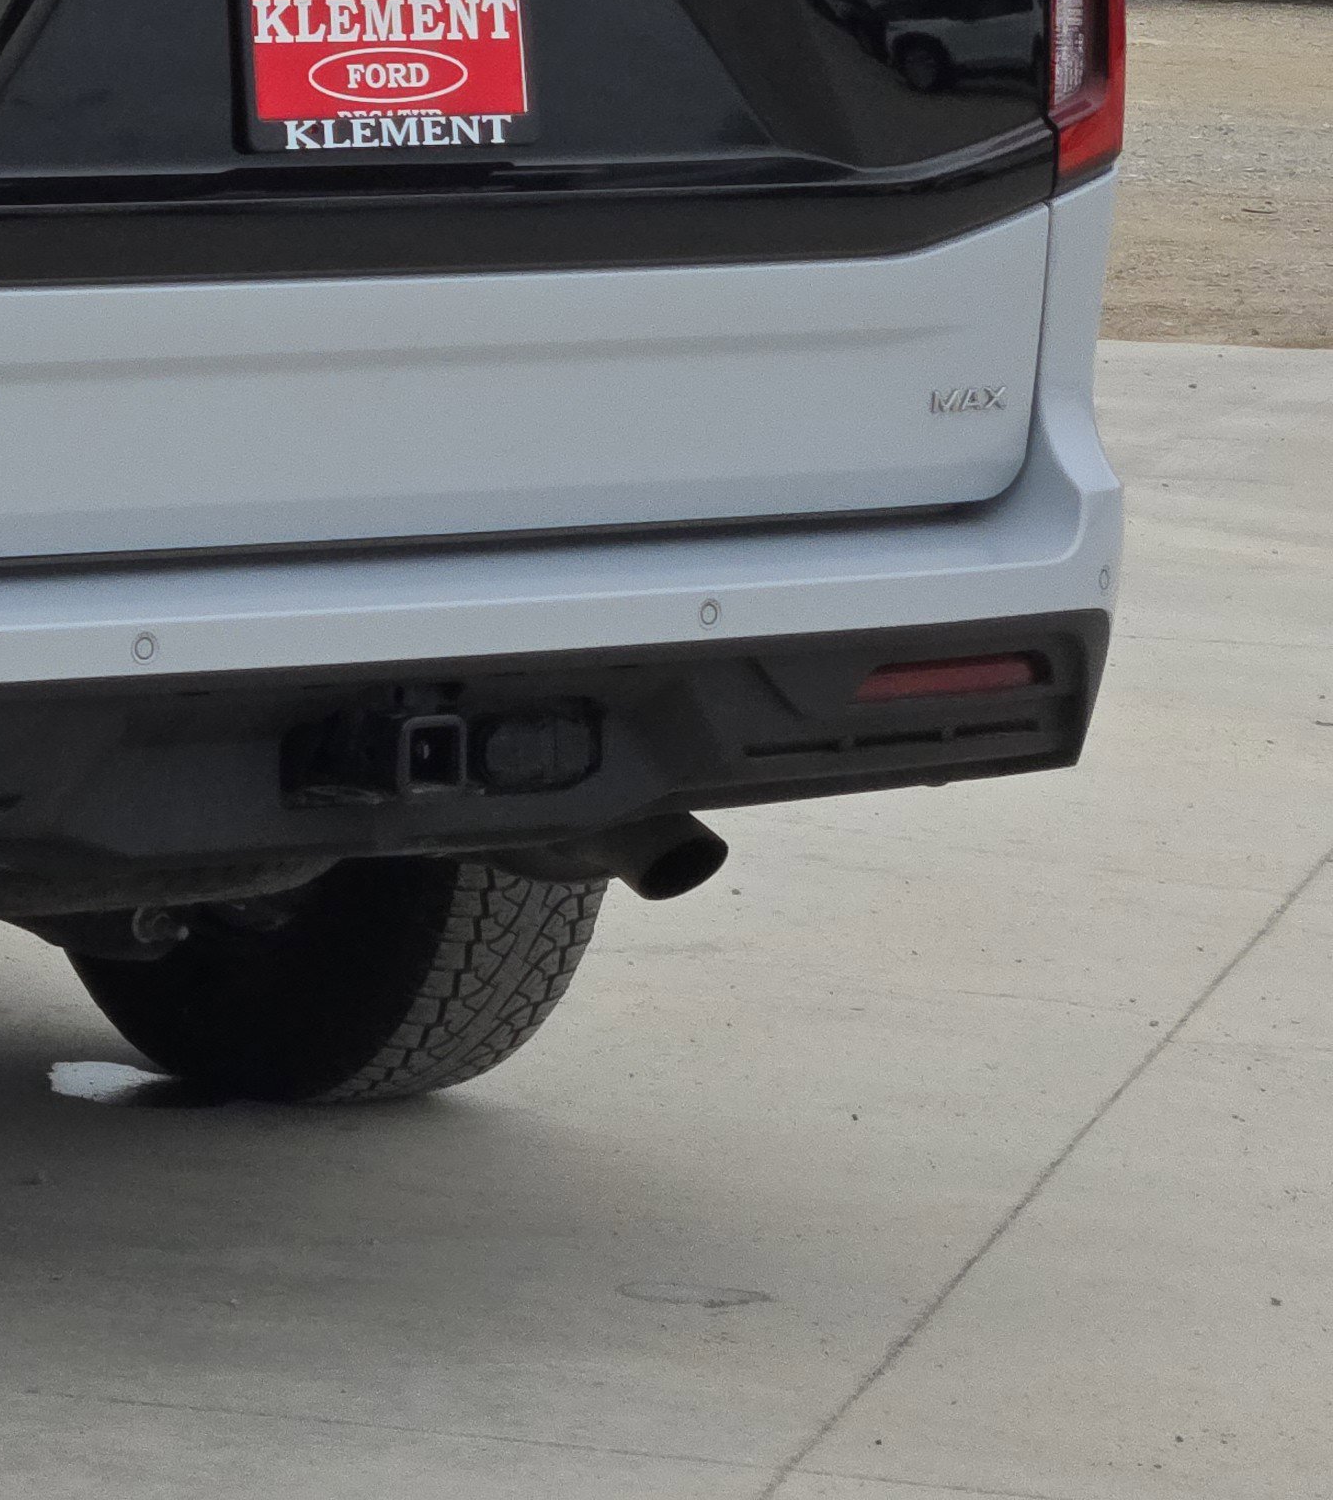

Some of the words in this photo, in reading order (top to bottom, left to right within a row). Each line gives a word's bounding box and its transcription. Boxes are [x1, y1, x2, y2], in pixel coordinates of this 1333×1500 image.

[346, 63, 430, 89] FORD
[283, 114, 512, 149] KLEMENT
[930, 386, 1007, 414] MAX
